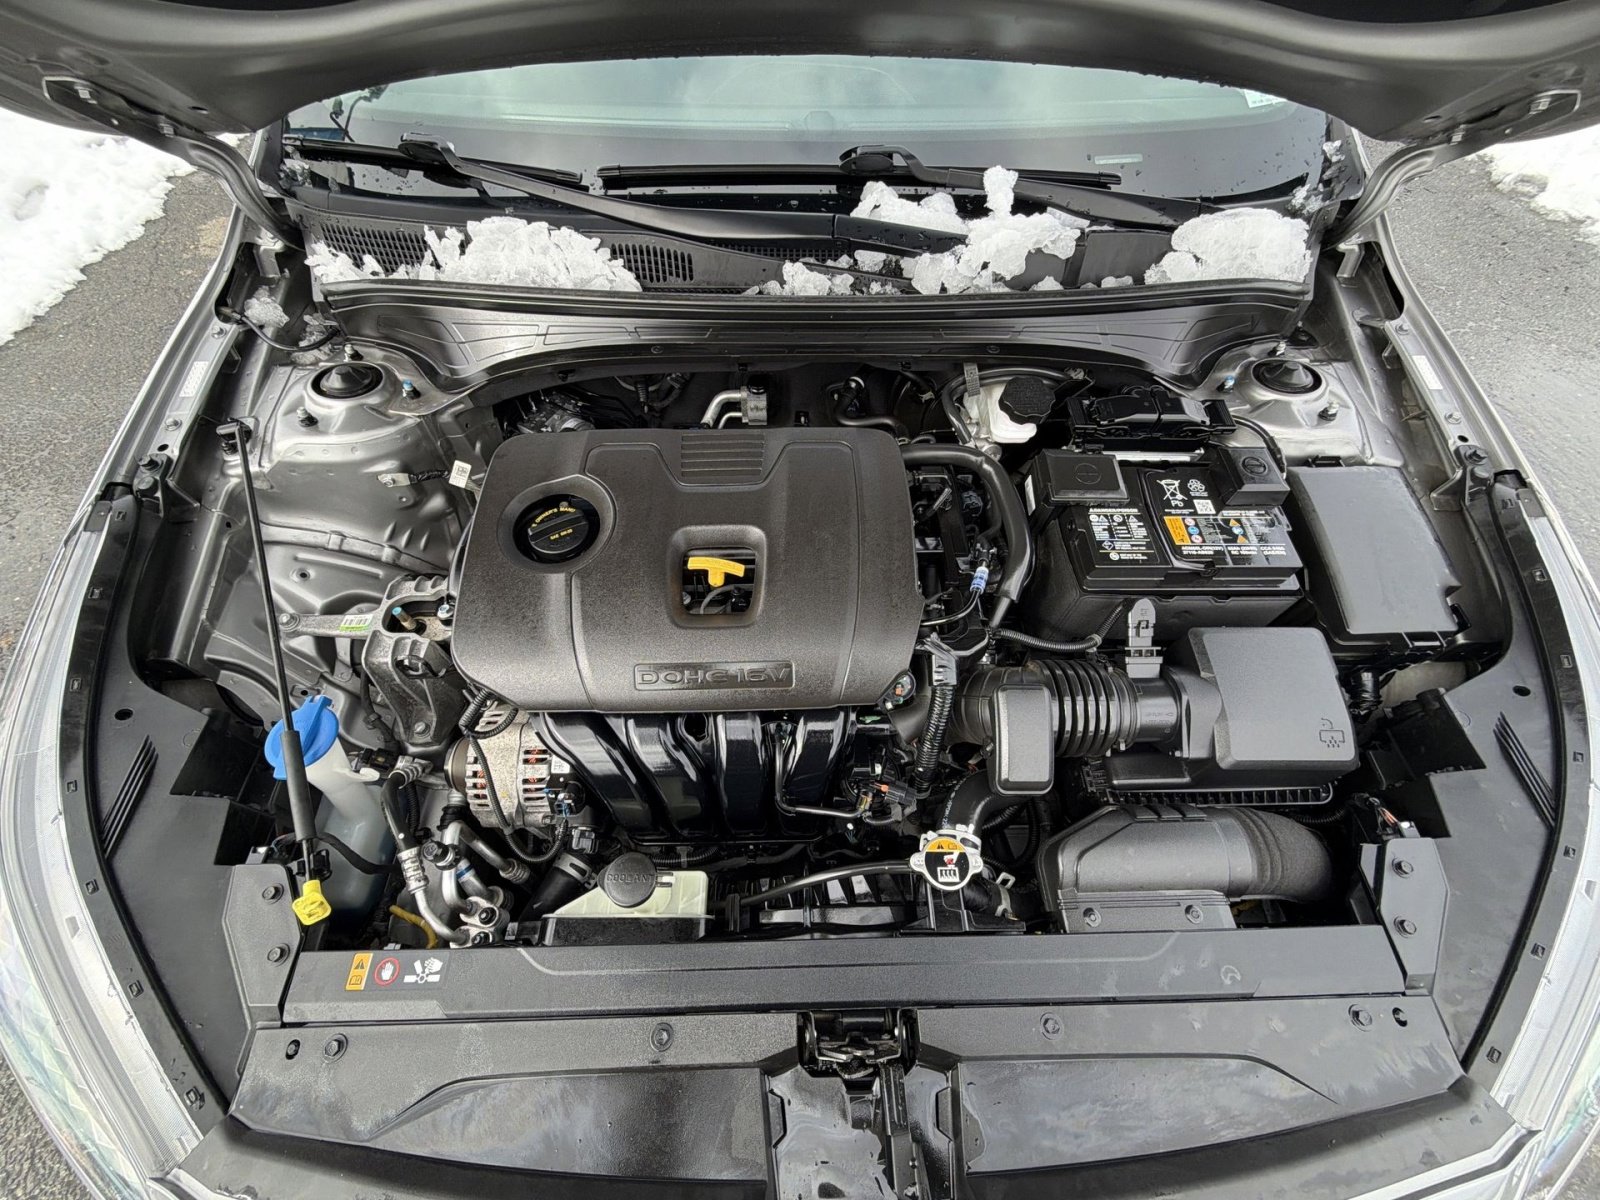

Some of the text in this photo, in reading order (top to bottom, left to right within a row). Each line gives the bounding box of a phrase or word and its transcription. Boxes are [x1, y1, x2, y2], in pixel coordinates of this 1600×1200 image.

[637, 667, 791, 685] DOHC 16V
[606, 873, 656, 883] COOLANT
